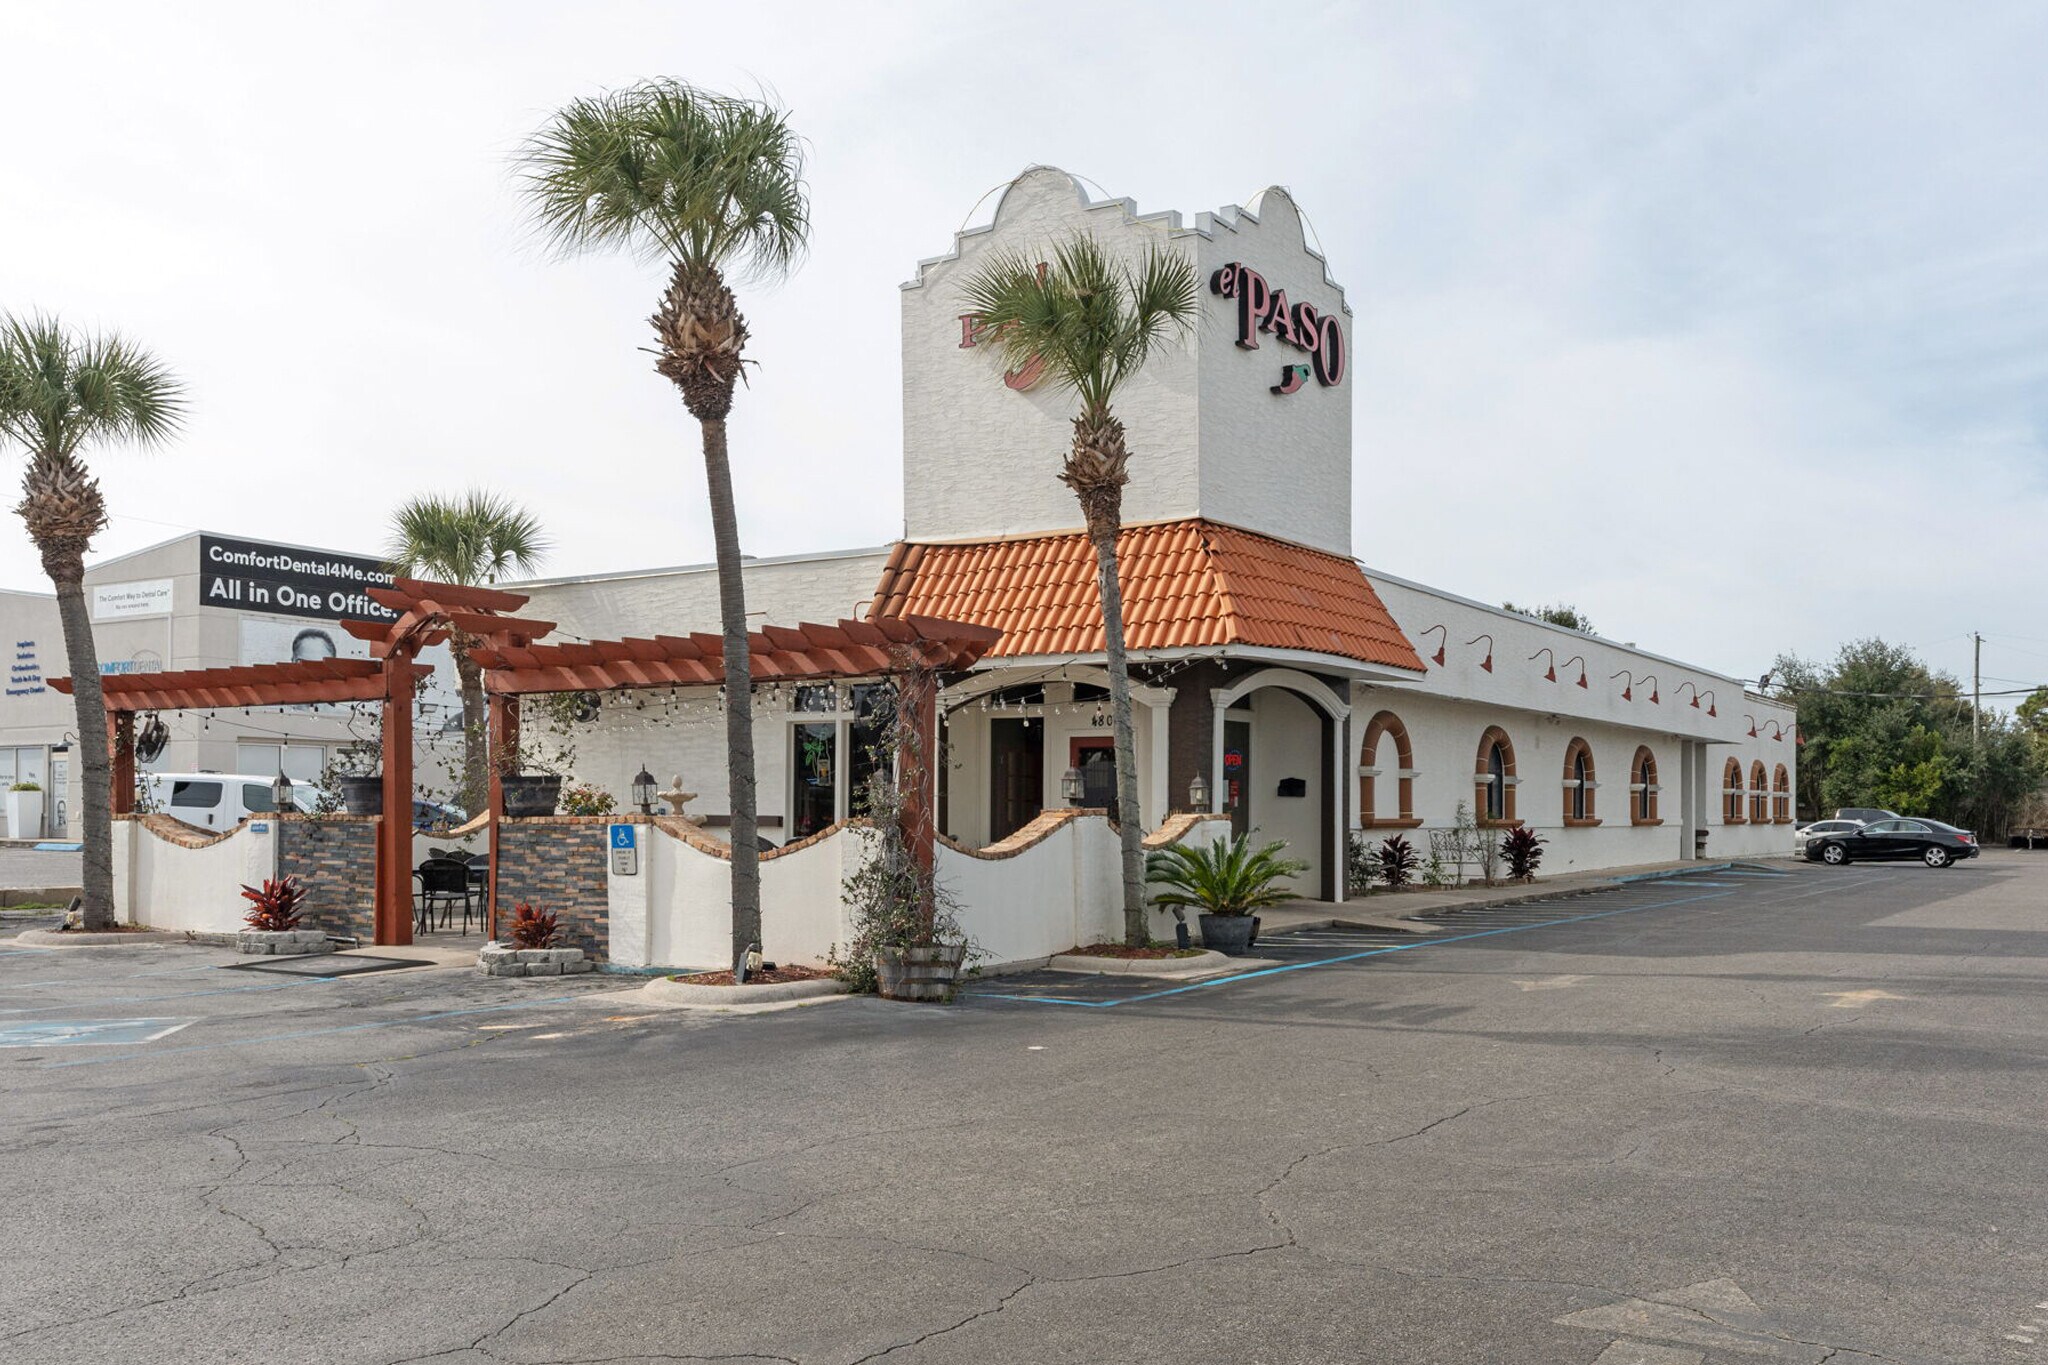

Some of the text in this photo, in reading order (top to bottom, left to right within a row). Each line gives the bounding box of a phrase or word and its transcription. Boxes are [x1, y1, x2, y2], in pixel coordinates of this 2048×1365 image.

[1211, 262, 1345, 386] el PASO
[108, 593, 125, 603] Comfort
[209, 577, 241, 601] All
[249, 581, 269, 604] in
[276, 585, 321, 610] One
[1225, 753, 1242, 767] OPEN
